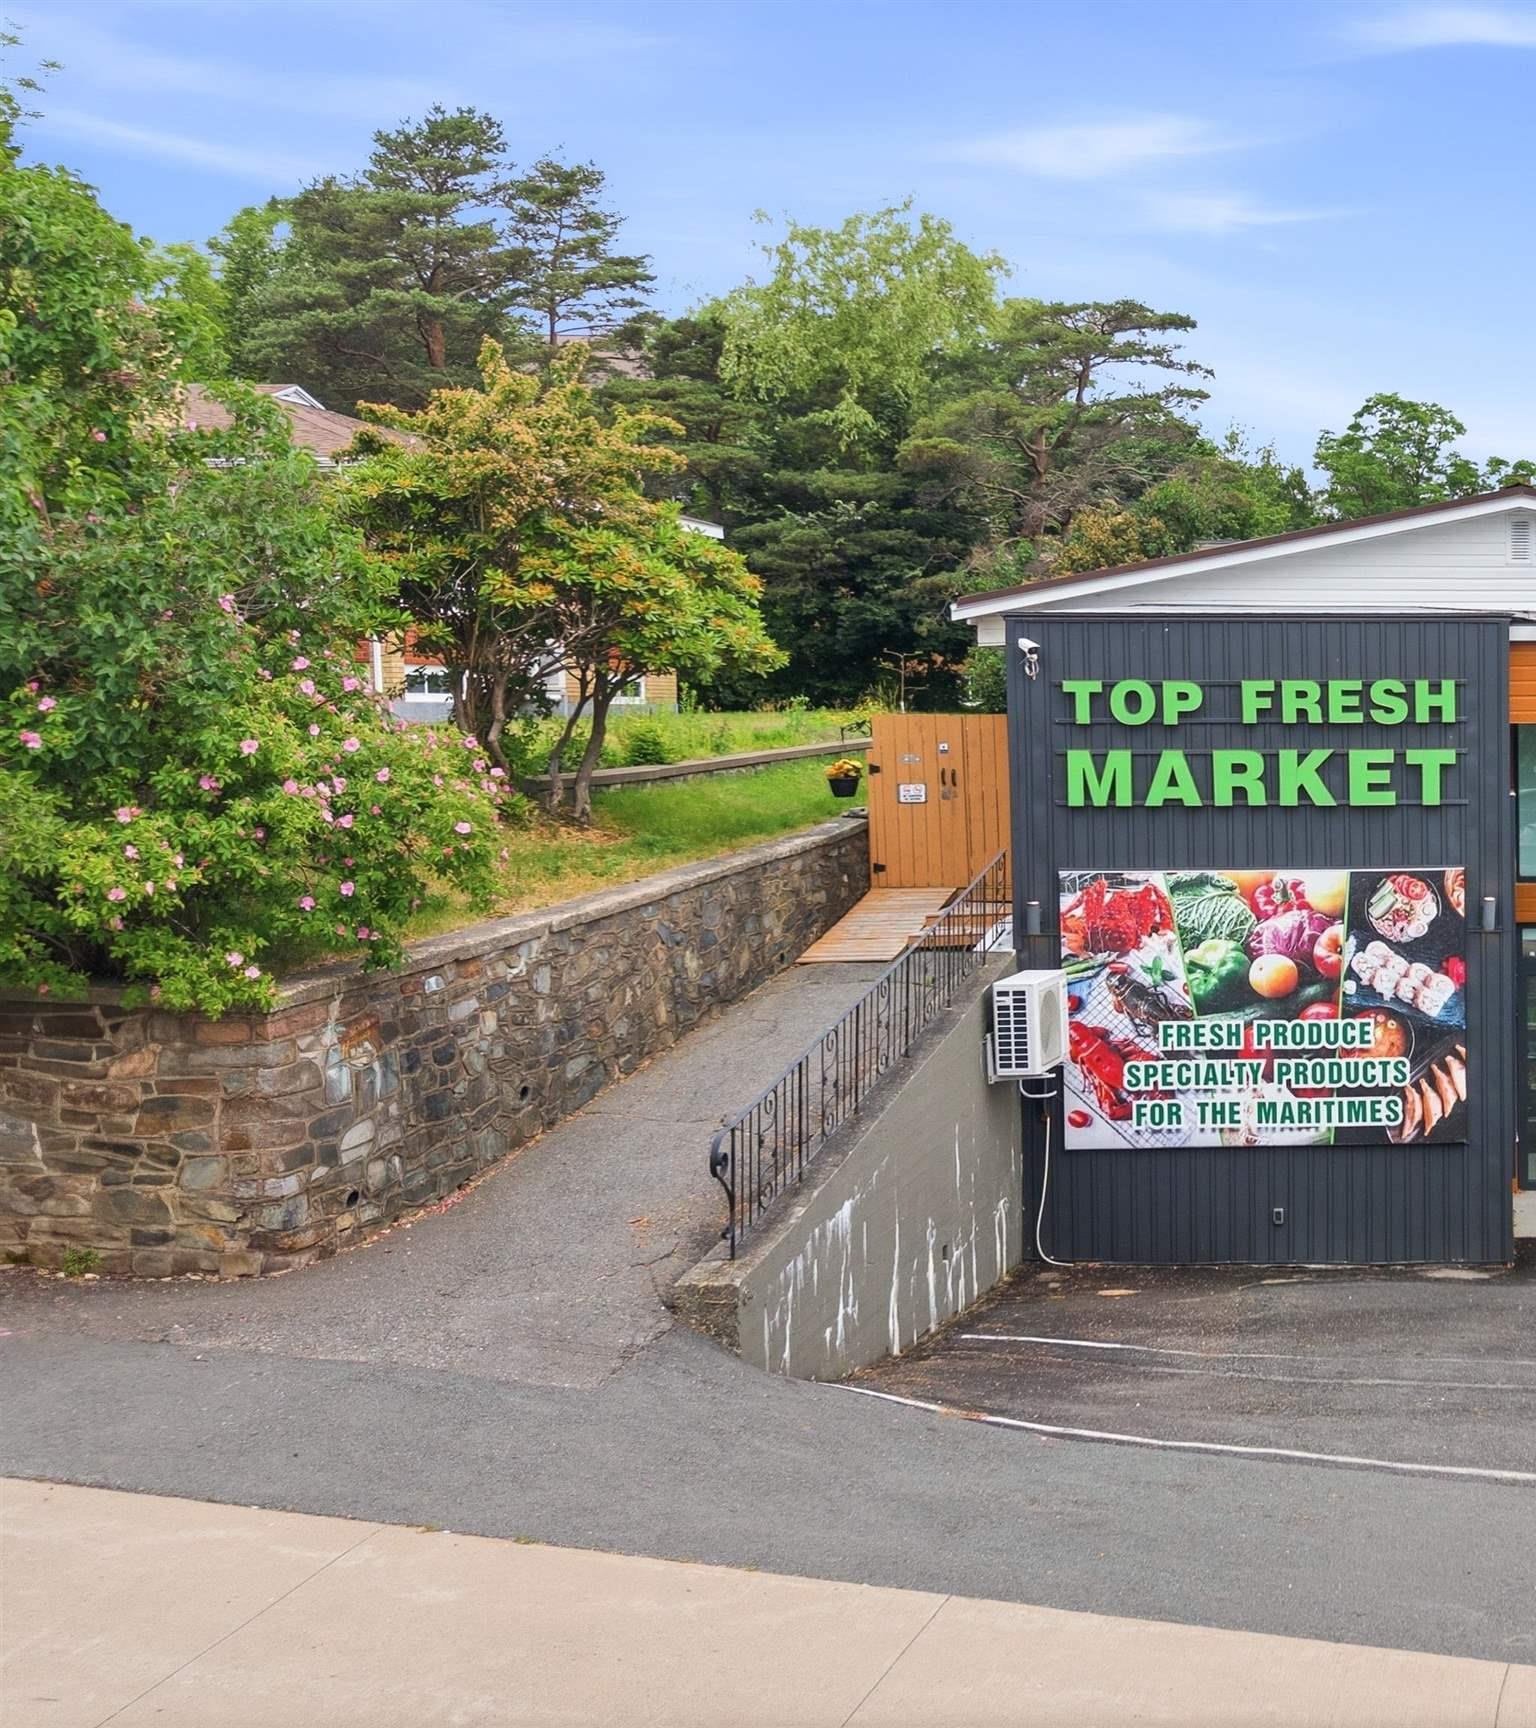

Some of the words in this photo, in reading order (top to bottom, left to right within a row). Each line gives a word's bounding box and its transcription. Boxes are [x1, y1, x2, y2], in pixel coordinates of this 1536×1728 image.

[1062, 679, 1203, 725] TOP
[1240, 679, 1457, 725] FRESH
[1065, 748, 1457, 807] MARKET
[1161, 1023, 1243, 1048] FRESH
[1256, 1020, 1372, 1047] PRODUCE
[1126, 1061, 1264, 1088] SPECIALTY
[1276, 1059, 1408, 1085] PRODUCTS
[1135, 1101, 1182, 1127] FOR
[1199, 1100, 1240, 1126] THE
[1256, 1098, 1401, 1124] MARITIMES
